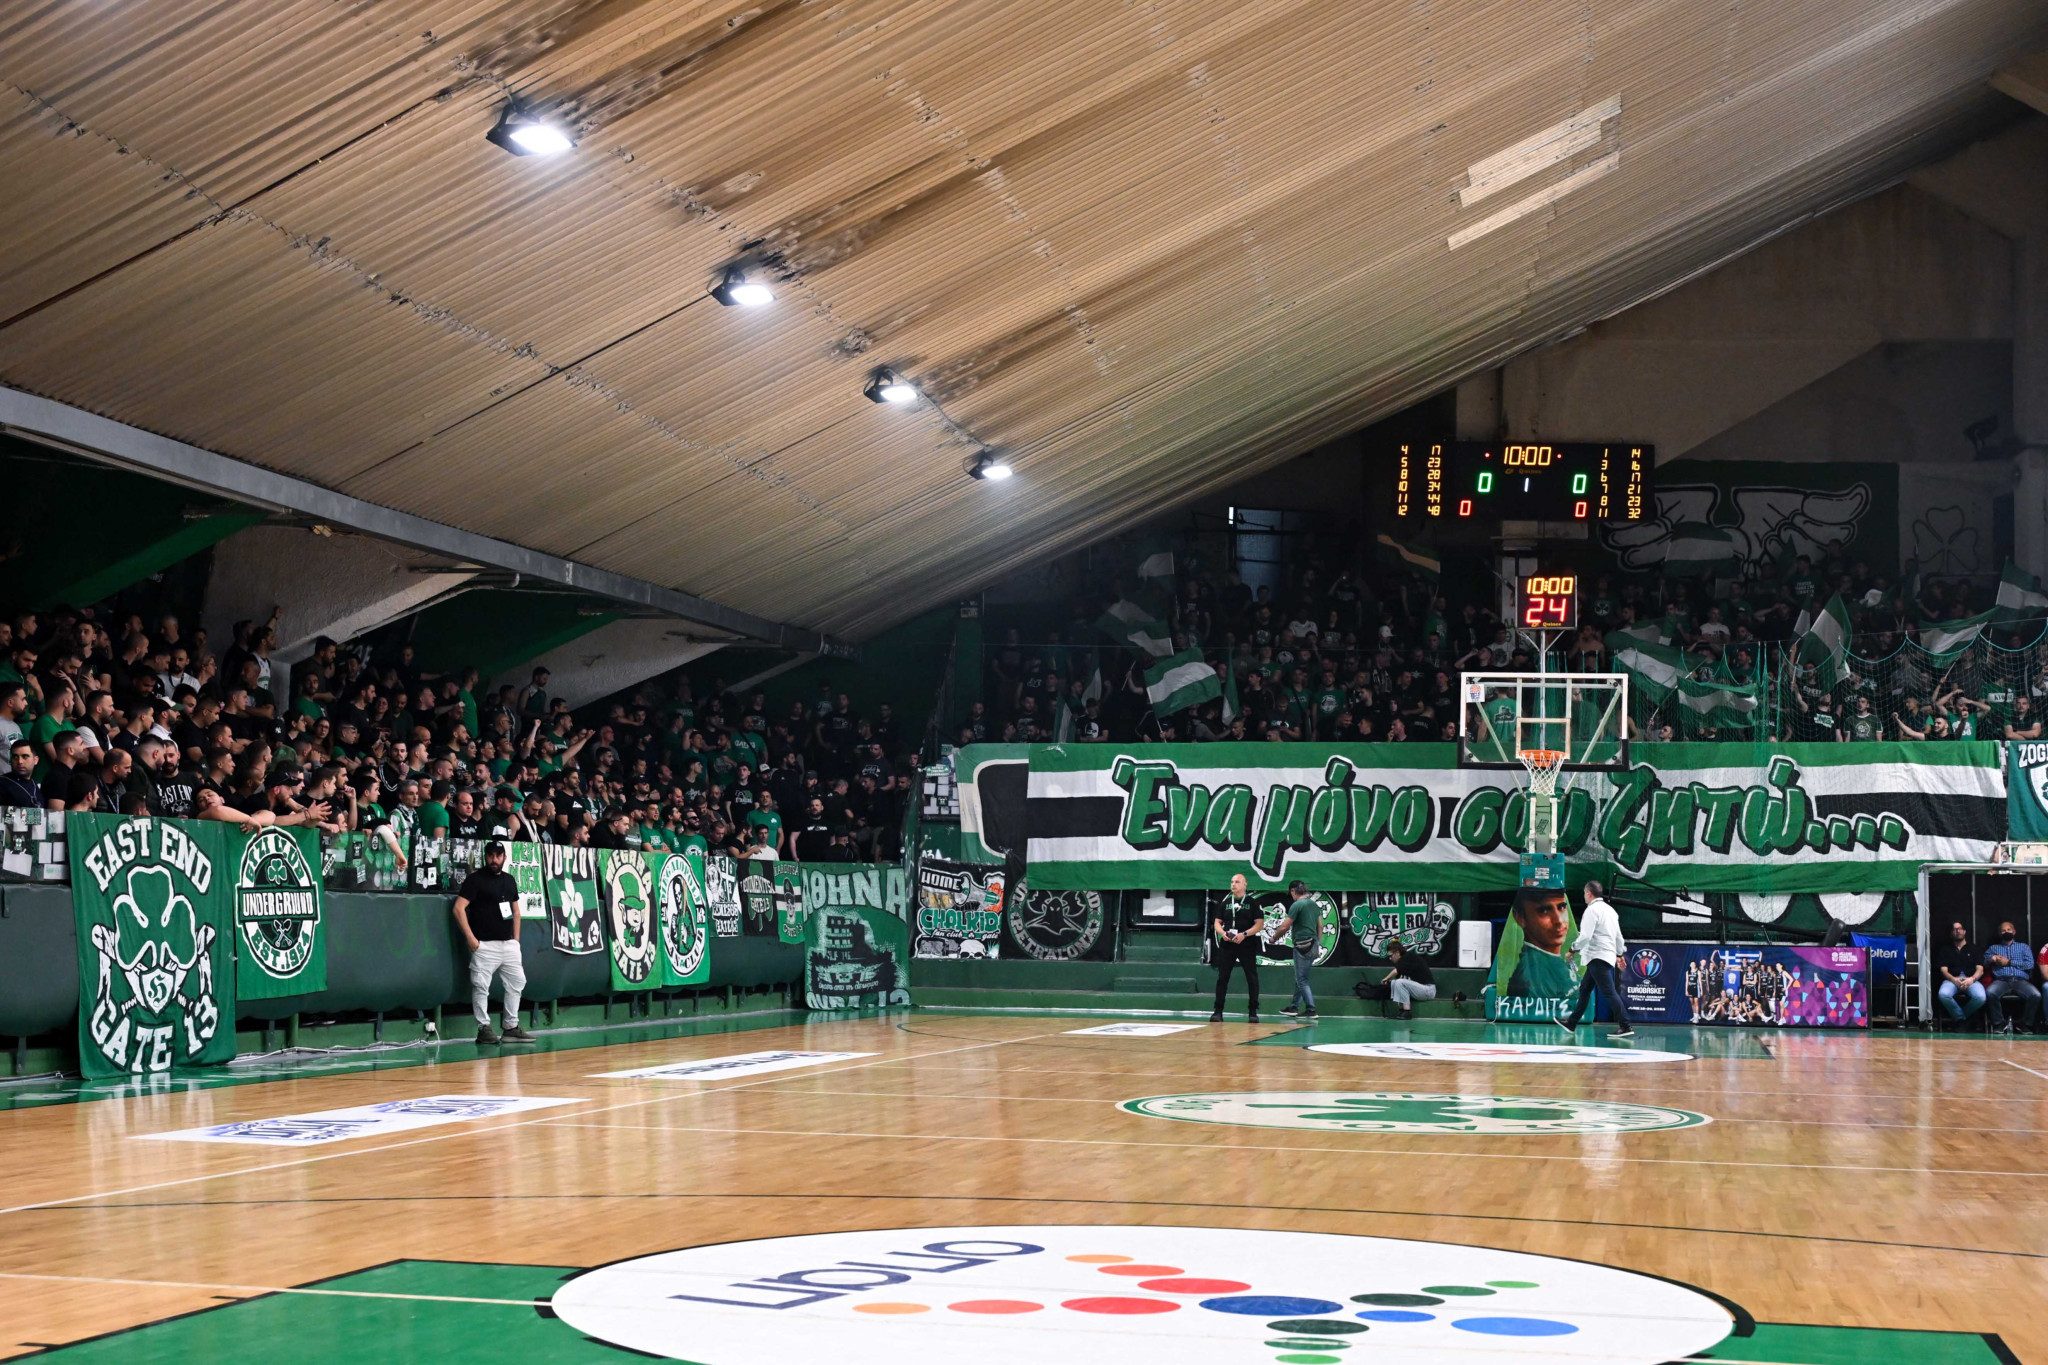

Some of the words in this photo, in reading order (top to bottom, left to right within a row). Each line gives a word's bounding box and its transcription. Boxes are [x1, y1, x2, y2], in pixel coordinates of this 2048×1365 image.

[1401, 445, 1408, 455] 4
[1431, 445, 1441, 456] 17
[1631, 448, 1641, 458] 14
[1504, 446, 1552, 466] 10:00
[1401, 457, 1408, 468] 5
[1428, 457, 1441, 468] 23
[1601, 460, 1608, 470] 3
[1401, 470, 1408, 480] 8
[1428, 470, 1441, 480] 28
[1631, 472, 1641, 482] 17
[1398, 482, 1408, 492] 10
[1428, 482, 1441, 492] 34
[1478, 472, 1492, 492] 0
[1572, 474, 1586, 494] 0
[1628, 484, 1641, 494] 21
[1398, 494, 1408, 504] 11
[1428, 494, 1441, 504] 44
[1600, 496, 1608, 506] 8
[1628, 496, 1641, 506] 23
[1398, 506, 1408, 516] 12
[1428, 506, 1441, 516] 48
[1460, 500, 1472, 516] 0
[1575, 502, 1587, 518] 0
[1598, 508, 1608, 518] 11
[1628, 508, 1641, 518] 32
[1527, 577, 1574, 594] 10:00
[1526, 598, 1567, 623] 24
[2018, 744, 2048, 768] ZOG
[1252, 756, 1434, 878] μόνο
[84, 818, 152, 892] EAST
[160, 822, 212, 894] END
[921, 872, 962, 890] HOME
[1377, 892, 1397, 906] KA
[920, 908, 1002, 932] CHALKID
[1382, 914, 1398, 929] TE
[1406, 914, 1424, 928] RO
[1011, 917, 1099, 960] PETRALONA
[612, 938, 642, 980] GATE
[1871, 949, 1897, 958] olten
[1628, 986, 1666, 994] EUROBASKET
[1498, 996, 1573, 1018] ΚΑΡΔΙΤΣ
[92, 1000, 174, 1072] GATE
[184, 995, 218, 1054] 13
